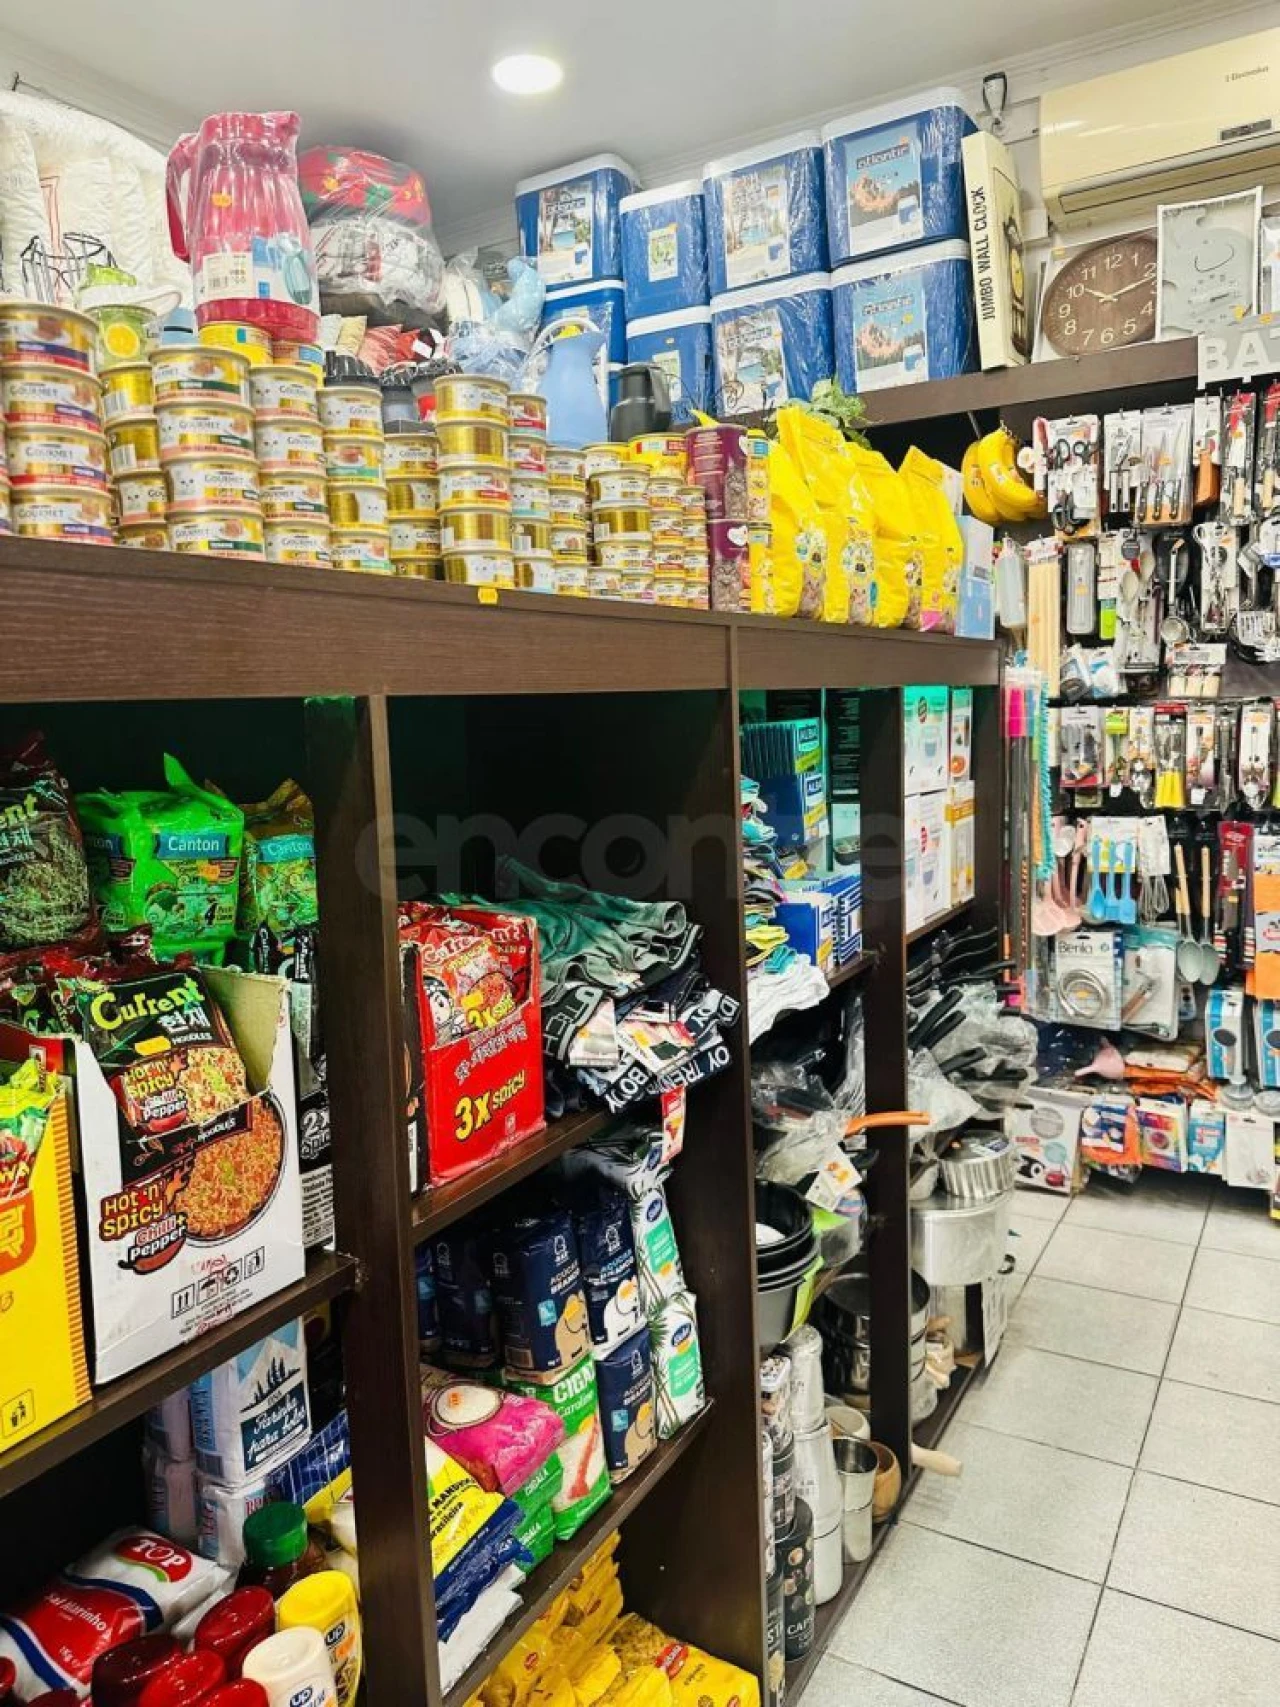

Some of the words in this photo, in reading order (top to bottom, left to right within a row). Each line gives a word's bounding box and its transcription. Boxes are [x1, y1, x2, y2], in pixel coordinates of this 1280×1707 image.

[970, 185, 988, 232] CLOCK
[975, 234, 991, 274] WALL
[1104, 253, 1123, 271] 12
[1131, 252, 1139, 267] 1
[1081, 265, 1097, 281] 11
[1143, 262, 1157, 278] 2
[980, 277, 996, 320] JUMBO
[1066, 283, 1085, 300] 10
[1059, 303, 1071, 318] 9
[1140, 300, 1154, 316] 4
[1064, 318, 1077, 336] 8
[1101, 327, 1115, 344] 6
[1122, 317, 1137, 336] 5
[1082, 327, 1095, 346] 7
[168, 836, 220, 852] Canton
[267, 841, 313, 857] Canton
[455, 1090, 492, 1141] 3x
[131, 1538, 187, 1568] TOP
[327, 1623, 345, 1644] UP
